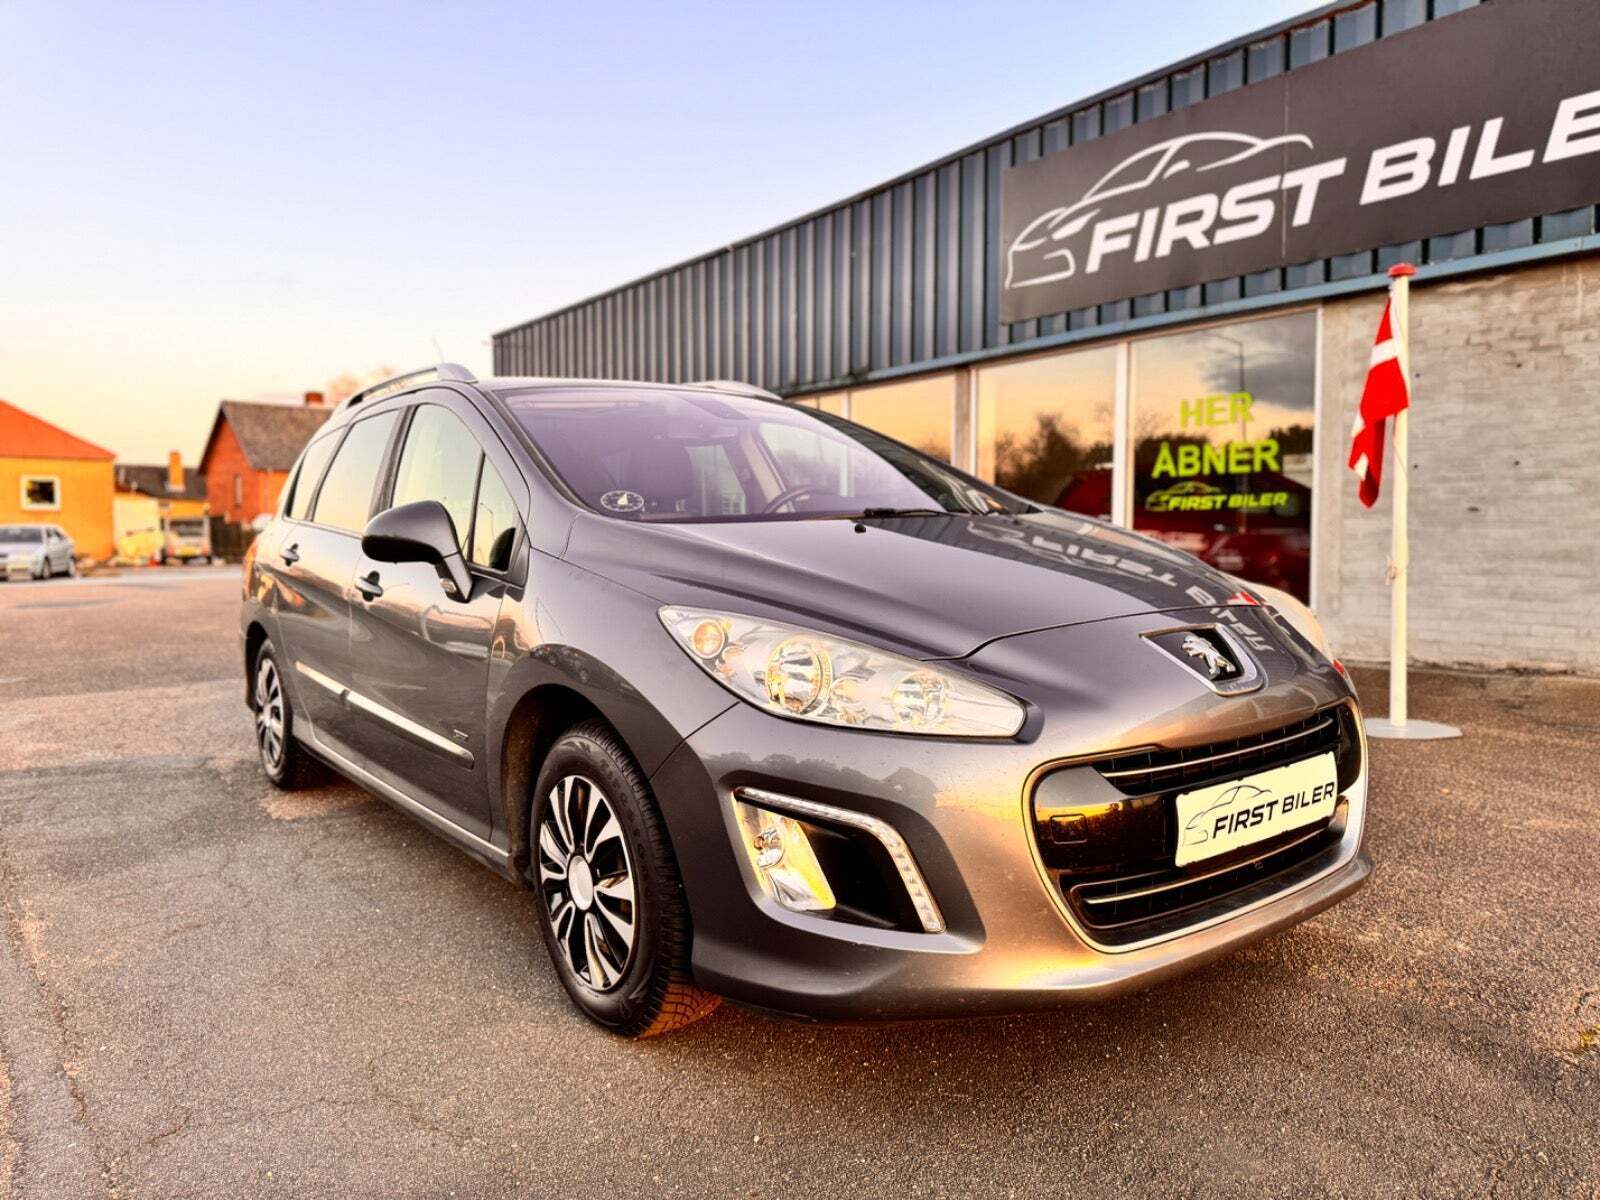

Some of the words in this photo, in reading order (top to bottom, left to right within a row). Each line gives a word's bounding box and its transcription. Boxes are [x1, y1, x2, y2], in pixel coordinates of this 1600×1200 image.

[1085, 158, 1347, 273] FIRST
[1179, 392, 1254, 427] HER
[1168, 494, 1227, 511] FIRST
[1228, 492, 1289, 508] BILER
[1212, 800, 1278, 839] FIRST
[1281, 781, 1335, 814] BILER
